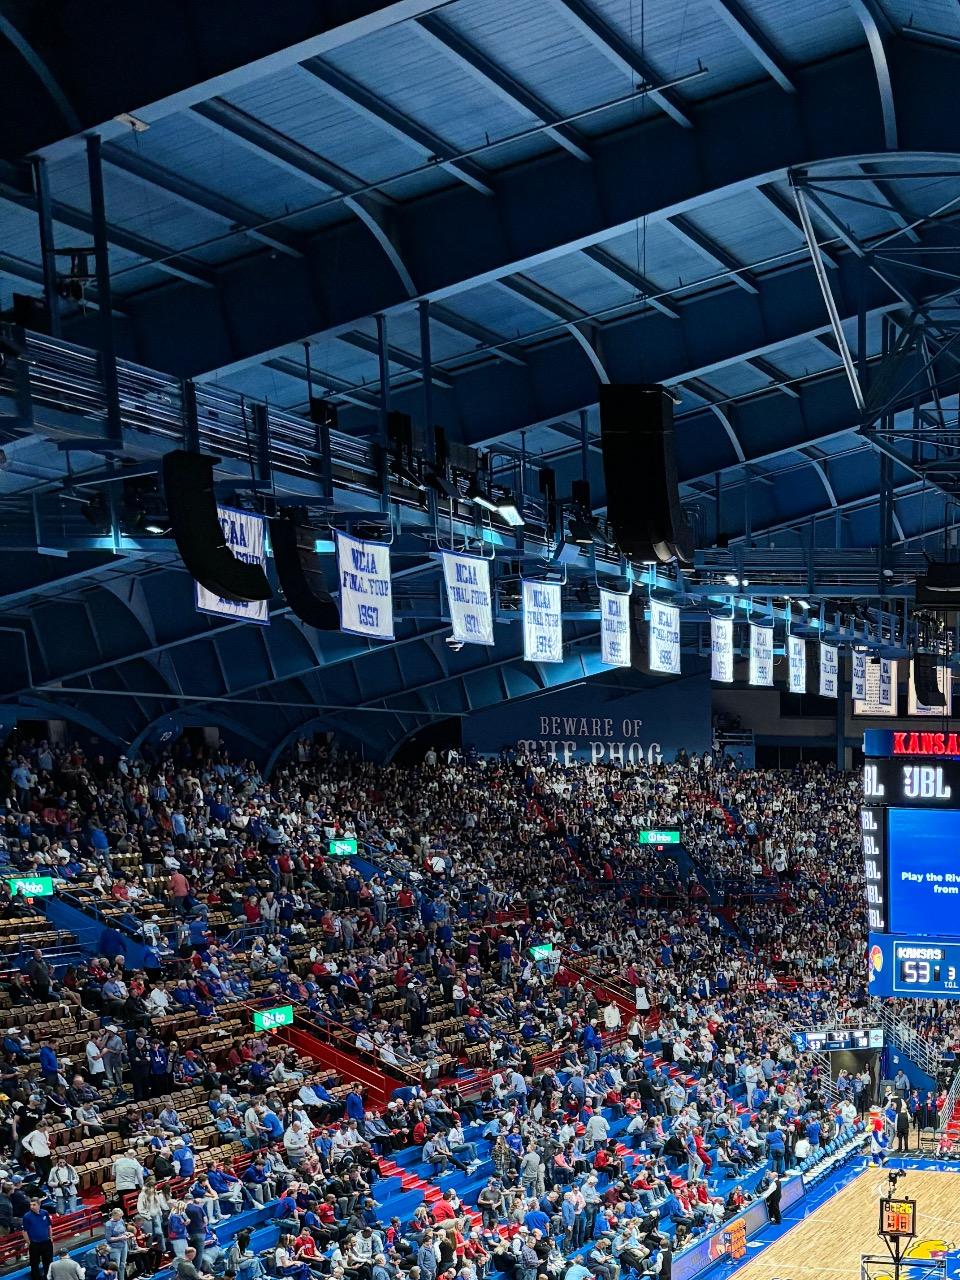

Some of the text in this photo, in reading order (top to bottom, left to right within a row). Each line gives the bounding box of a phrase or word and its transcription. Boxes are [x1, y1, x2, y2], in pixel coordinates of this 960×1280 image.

[220, 518, 248, 548] CAA
[455, 563, 478, 585] NCAA
[358, 603, 379, 628] 1957
[540, 716, 643, 738] BEWARE OF
[589, 741, 663, 769] PHOG
[904, 766, 952, 798] JBL
[901, 872, 923, 883] Play
[925, 872, 943, 882] the
[933, 885, 958, 894] from
[897, 947, 942, 960] KANSAS
[903, 961, 930, 983] 53
[948, 966, 956, 980] 3
